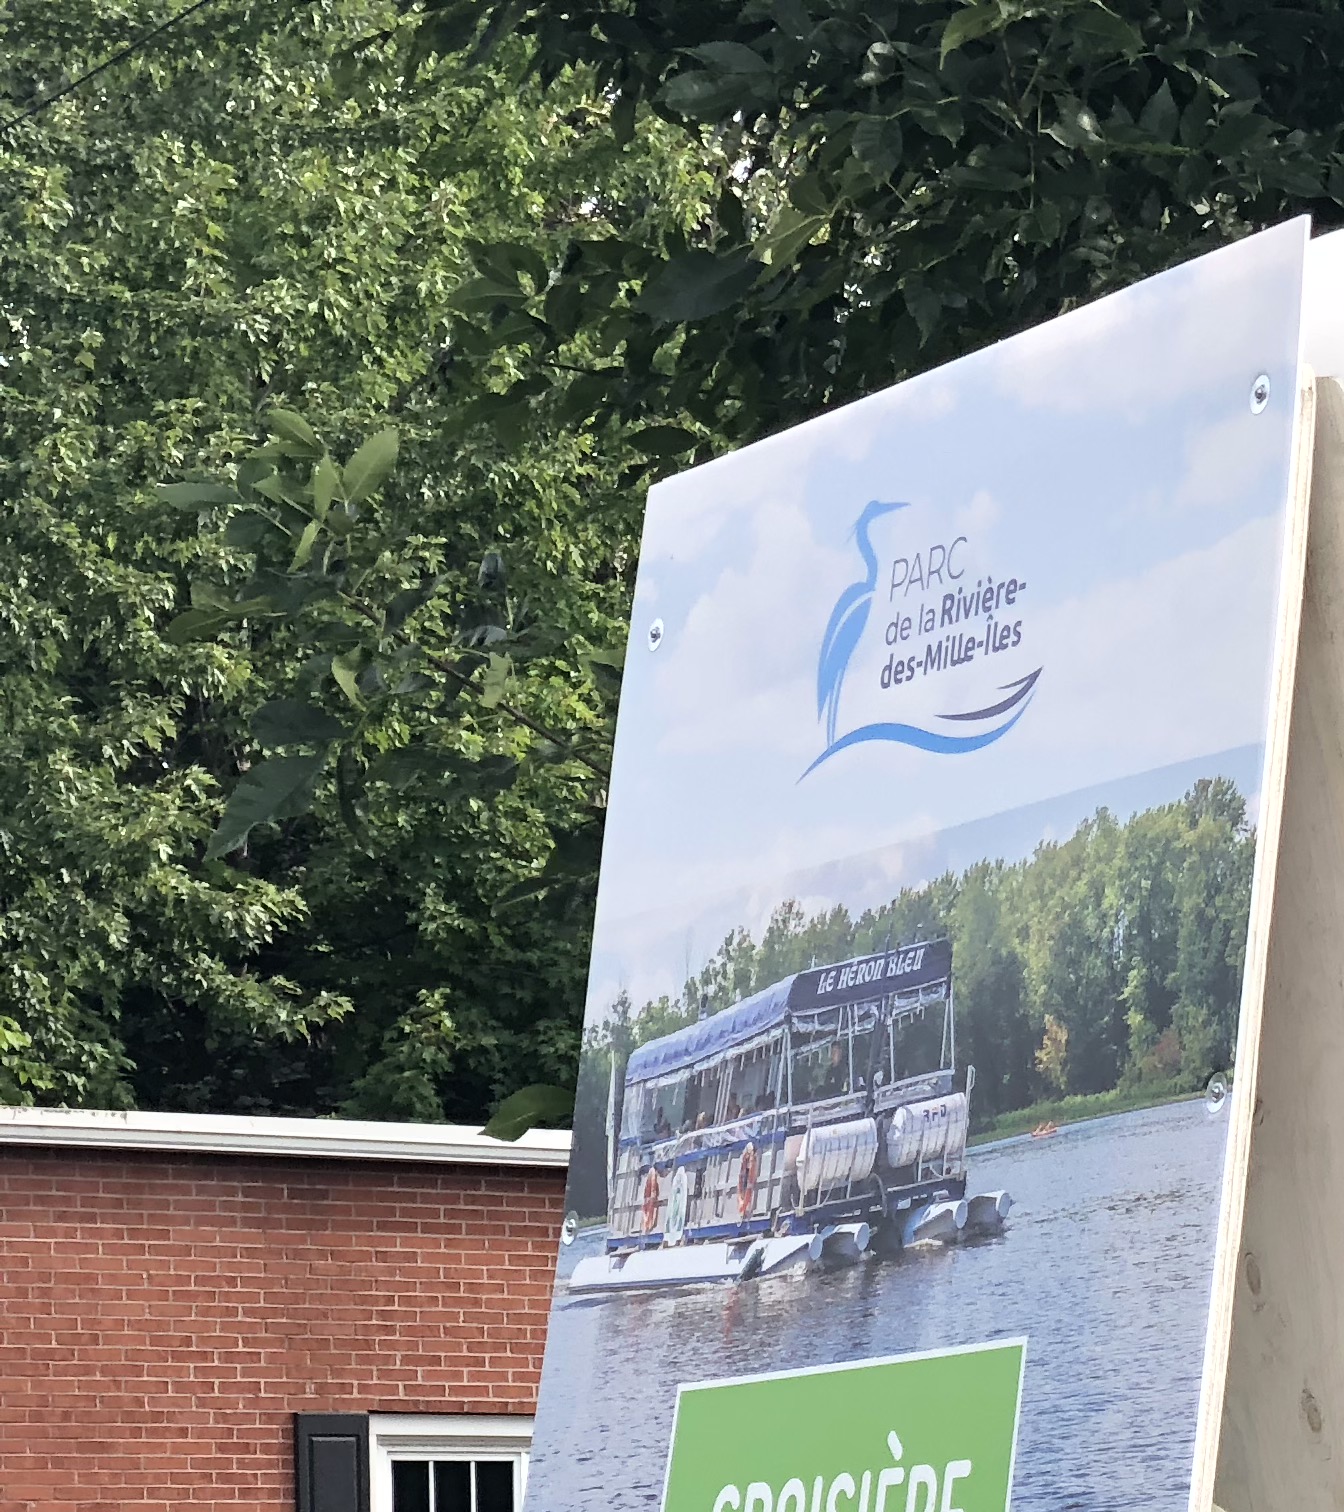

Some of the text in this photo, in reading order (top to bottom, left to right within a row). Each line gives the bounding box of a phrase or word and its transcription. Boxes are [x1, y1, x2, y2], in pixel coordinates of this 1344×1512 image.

[889, 536, 968, 603] PARC
[885, 575, 1027, 646] de la Rivière-
[880, 616, 1023, 689] des-Mille-Îles
[816, 970, 837, 995] LE
[886, 948, 926, 977] BLEU
